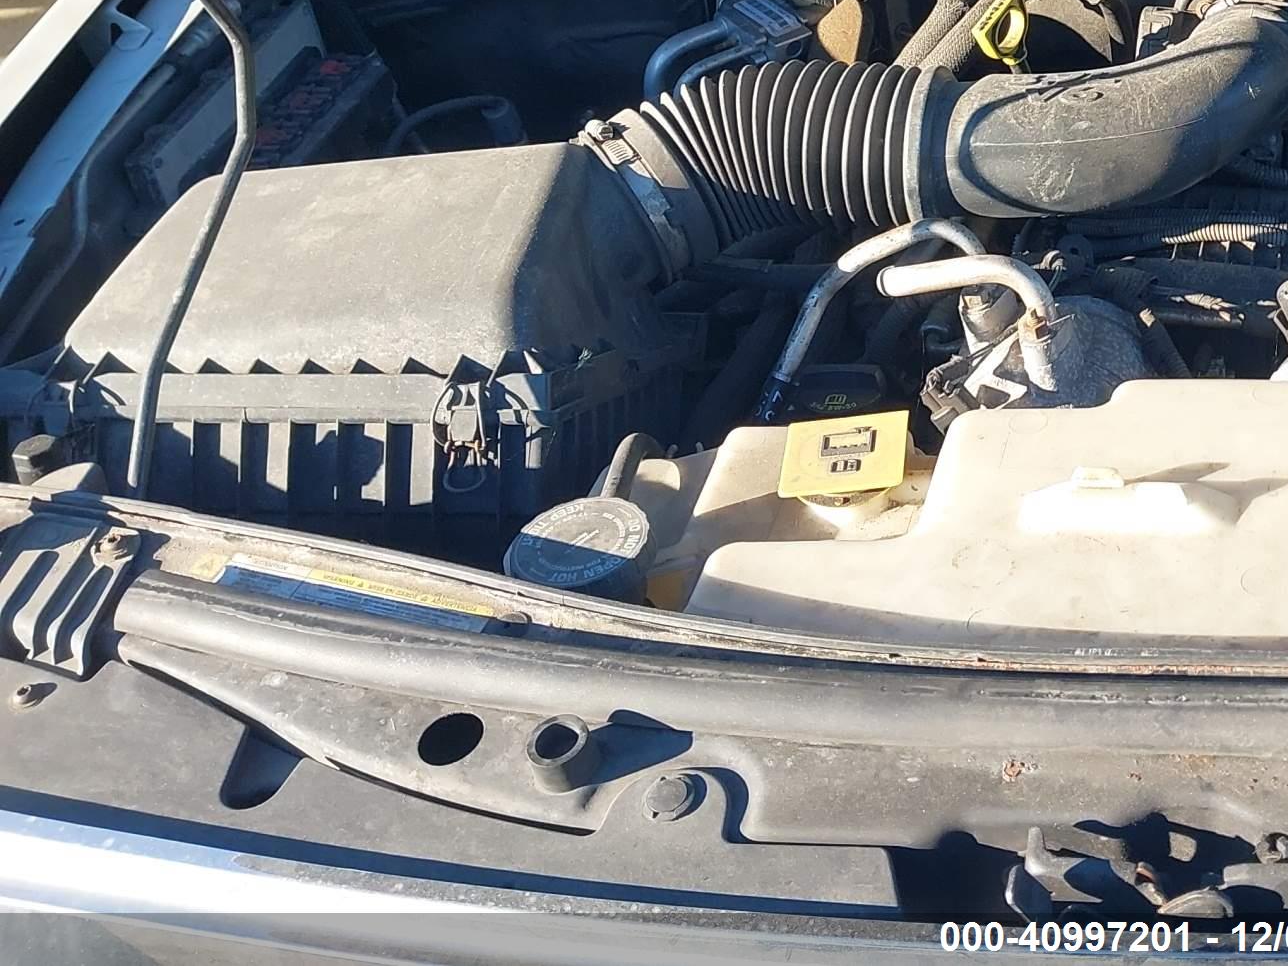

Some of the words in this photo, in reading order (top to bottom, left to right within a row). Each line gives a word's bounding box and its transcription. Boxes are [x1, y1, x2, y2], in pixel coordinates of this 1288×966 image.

[549, 503, 585, 522] KEEP
[627, 518, 641, 533] DO
[620, 534, 641, 555] NOT
[549, 571, 578, 583] HOT
[583, 556, 622, 579] OPEN
